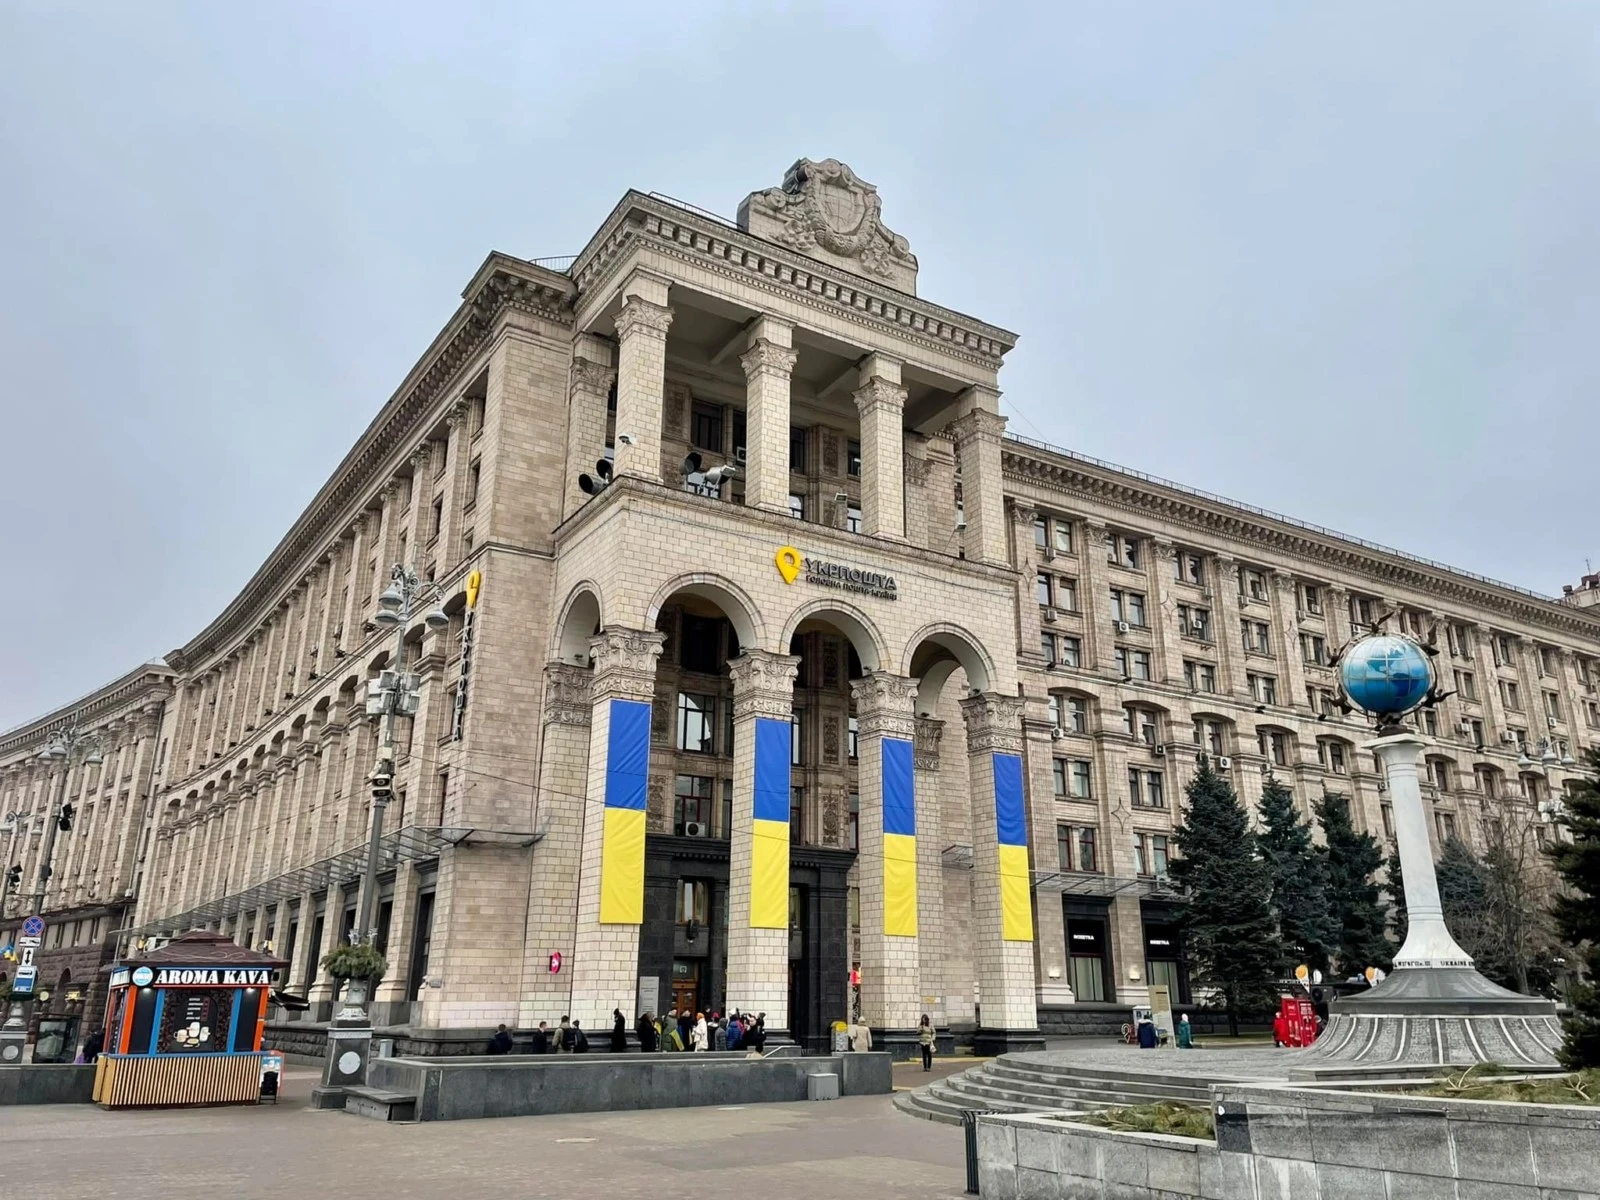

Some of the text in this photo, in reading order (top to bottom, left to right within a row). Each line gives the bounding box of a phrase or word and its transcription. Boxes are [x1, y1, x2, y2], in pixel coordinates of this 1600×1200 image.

[805, 558, 897, 590] УКРПОШТА
[155, 970, 218, 984] AROMA
[223, 970, 269, 984] KAVA
